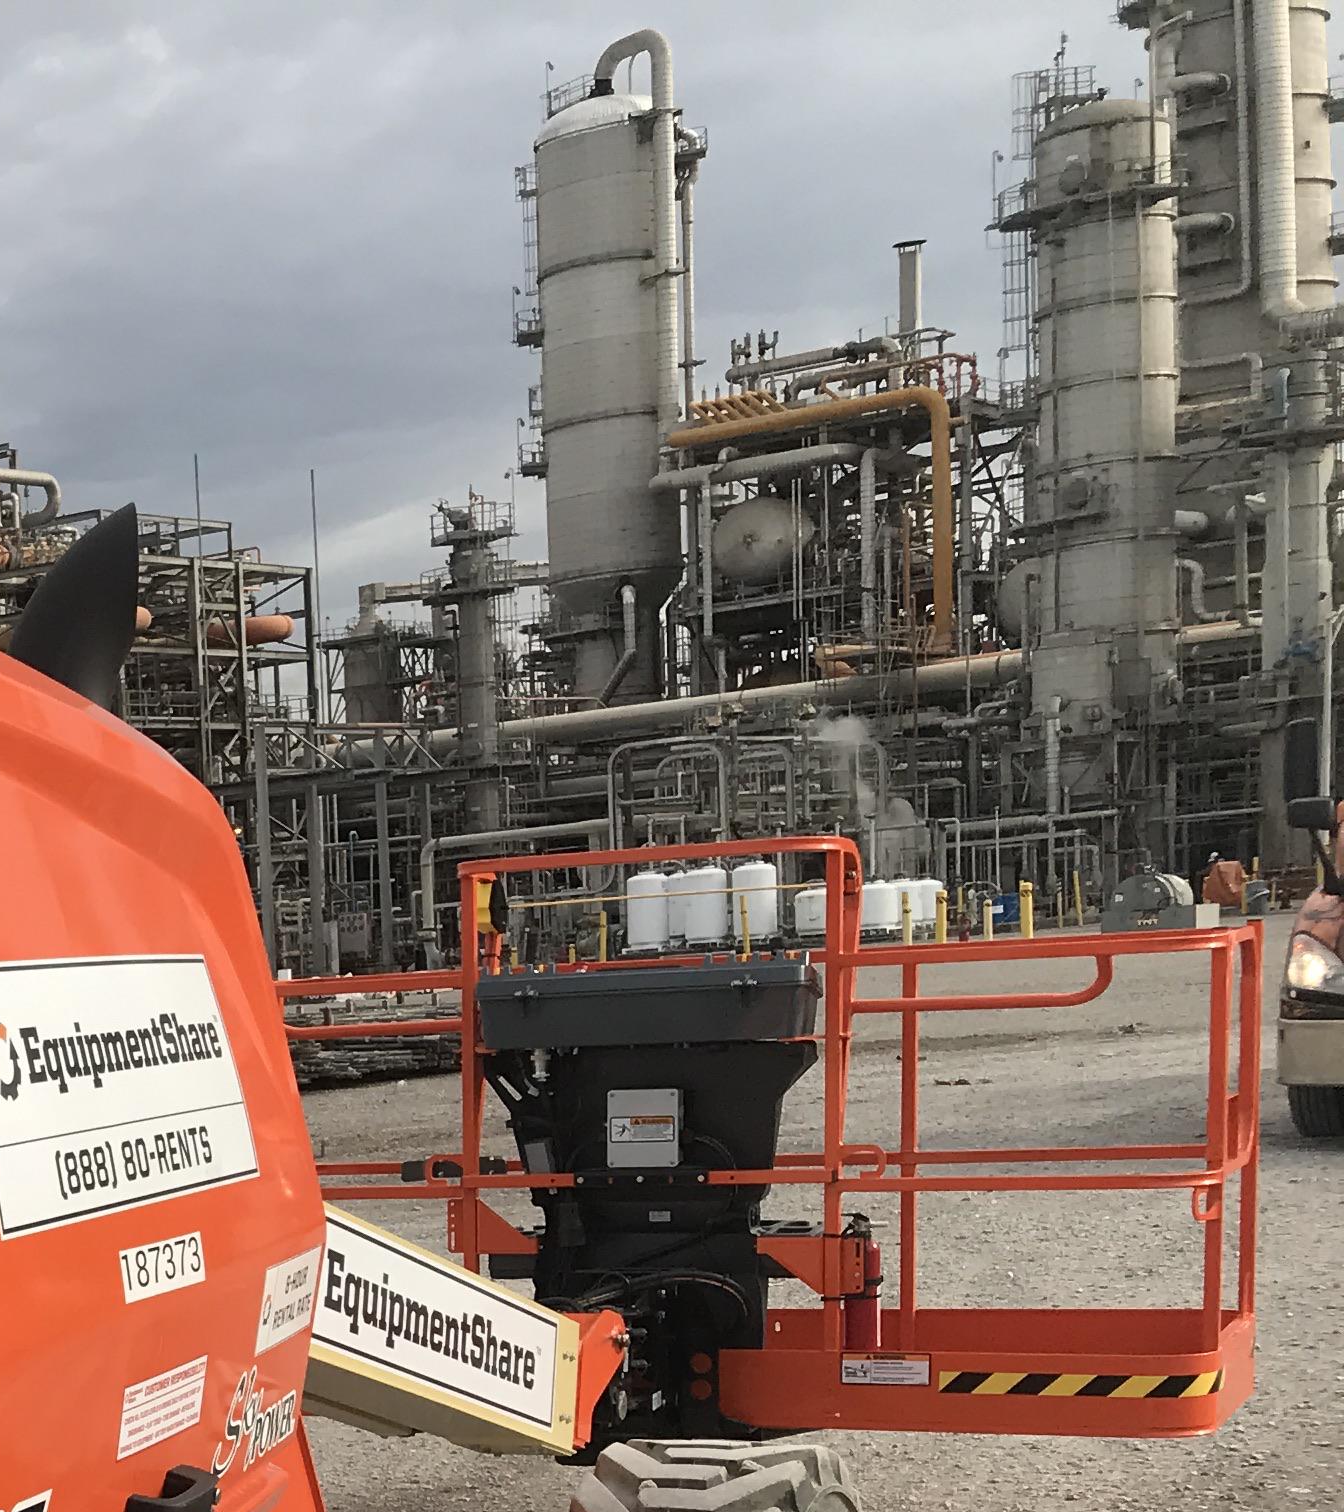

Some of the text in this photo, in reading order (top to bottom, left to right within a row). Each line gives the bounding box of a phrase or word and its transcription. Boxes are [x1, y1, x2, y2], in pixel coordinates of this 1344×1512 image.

[19, 1012, 223, 1094] EquipmentShare
[54, 1126, 213, 1200] (888) 80-RENTS
[121, 1236, 203, 1291] 187373
[323, 1248, 536, 1391] EquipmentShare
